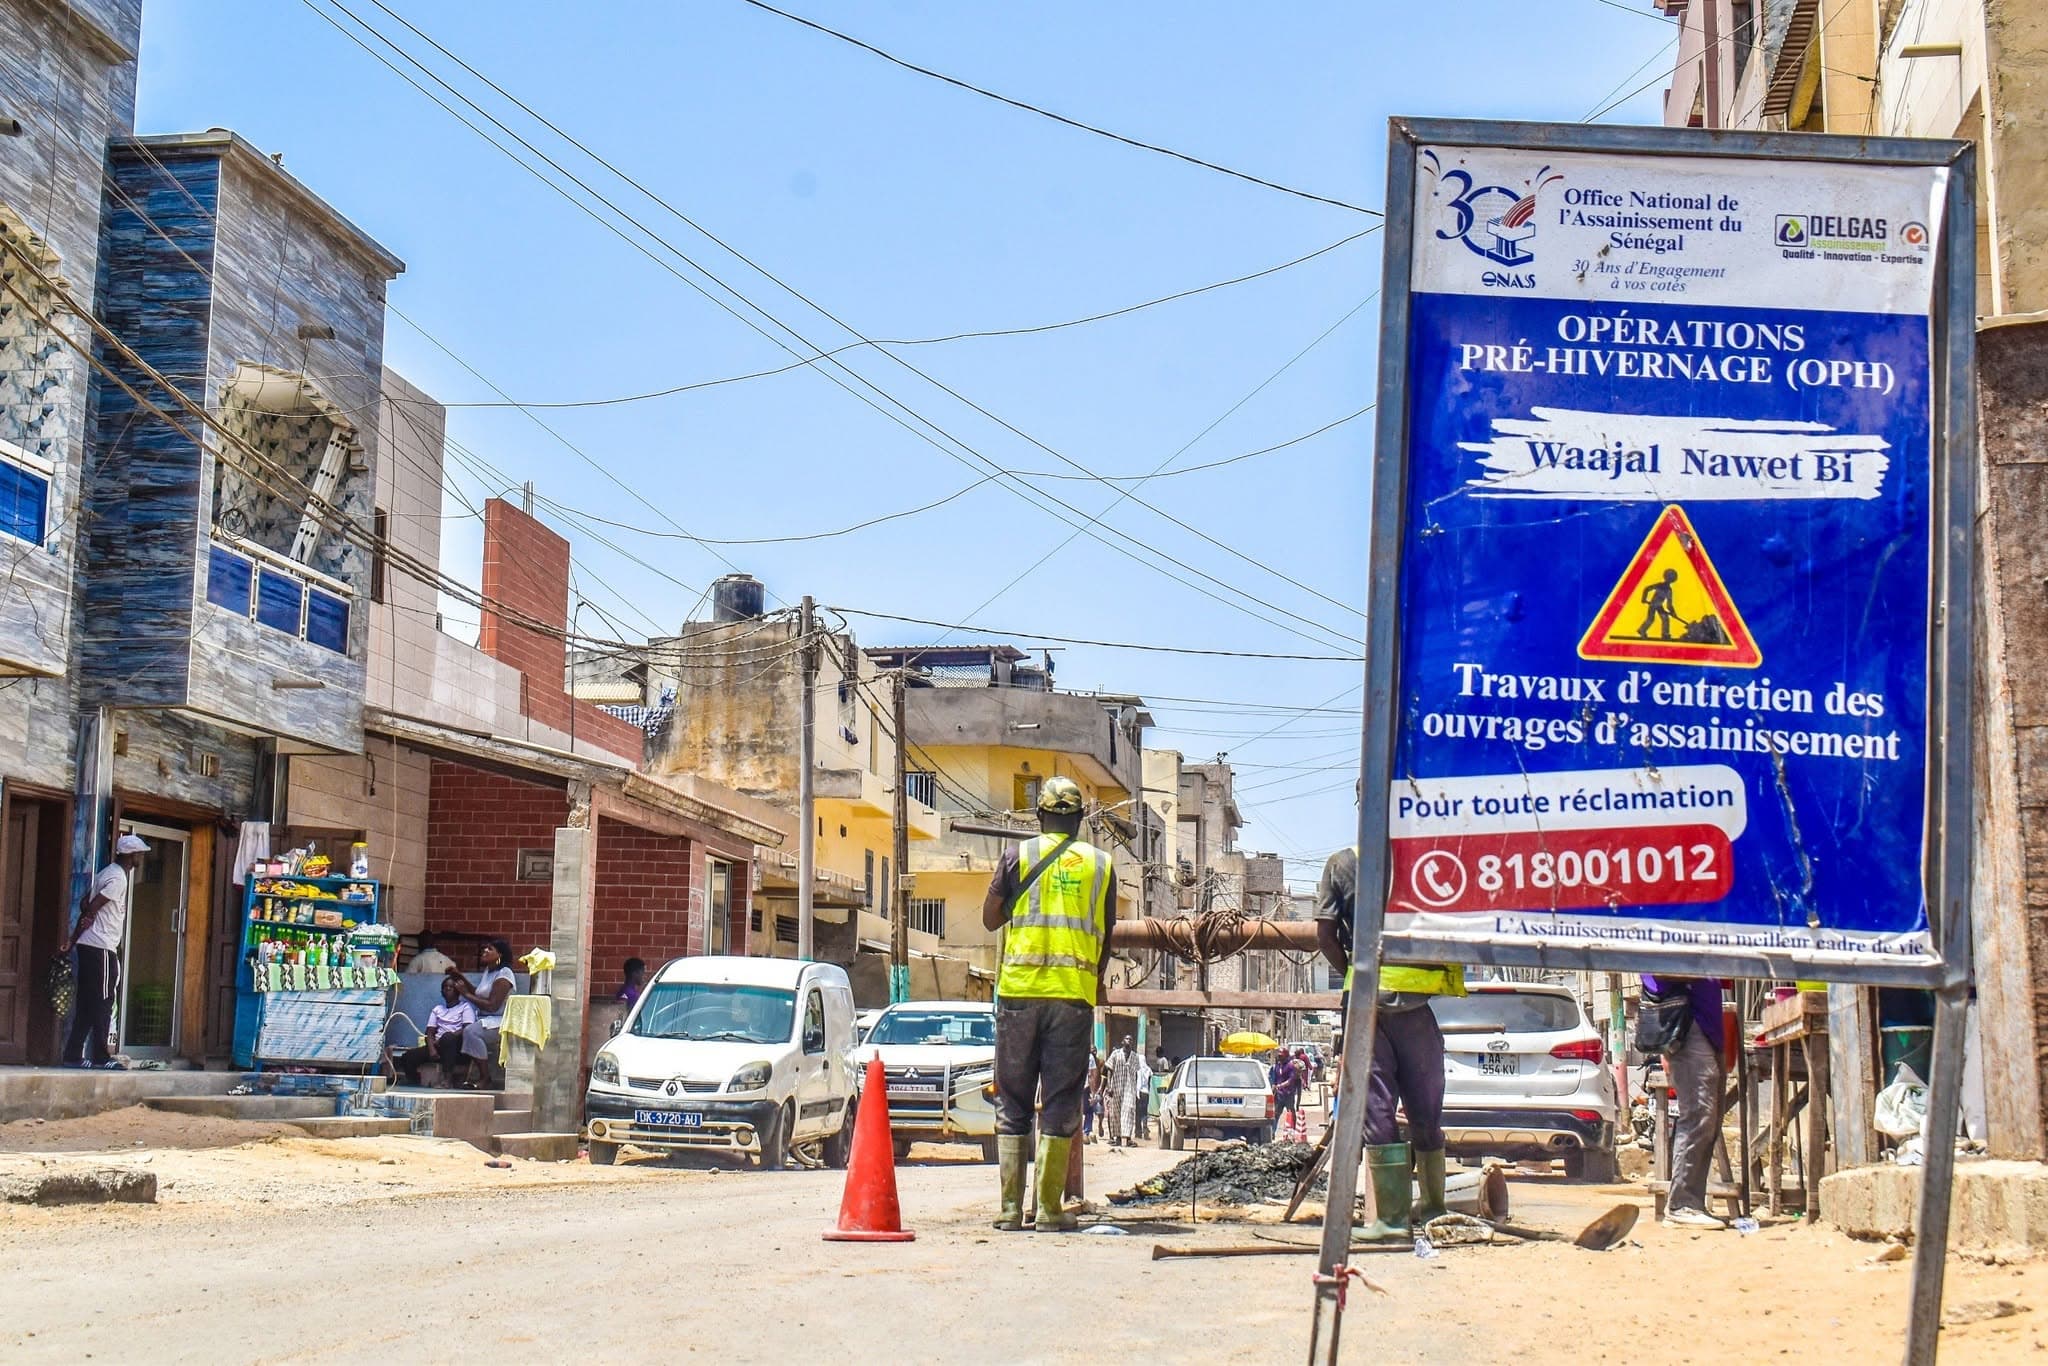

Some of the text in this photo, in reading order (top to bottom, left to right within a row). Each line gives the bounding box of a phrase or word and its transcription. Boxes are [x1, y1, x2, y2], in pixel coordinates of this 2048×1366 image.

[1564, 188, 1739, 211] Office National de
[1559, 209, 1742, 232] l’Assainissement du
[1810, 215, 1887, 240] DELGAS
[1610, 231, 1684, 254] Sénégal
[1810, 238, 1886, 251] Assainissement
[1782, 249, 1815, 260] Qualité
[1823, 251, 1872, 262] Innovation
[1881, 254, 1923, 265] Expertise
[1572, 259, 1726, 282] 30 Ans d’Engagement
[1610, 277, 1687, 292] à vos cotés
[1557, 310, 1805, 352] OPÉRATIONS
[1460, 339, 1896, 396] PRÉ-HIVERNAGE (OPH)
[1526, 440, 1854, 483] Waajal Nawet Bi
[1453, 662, 1884, 717] Travaux d’entretien des
[1422, 711, 1901, 760] ouvrages d’assainissement
[1399, 785, 1735, 818] Pour toute réclamation
[1477, 843, 1718, 891] 818001012
[1495, 916, 1924, 955] L’Assainissement pour un meilleur cadre de vie
[1482, 1064, 1516, 1075] 554 KV
[640, 1111, 697, 1125] DK-3720-AU
